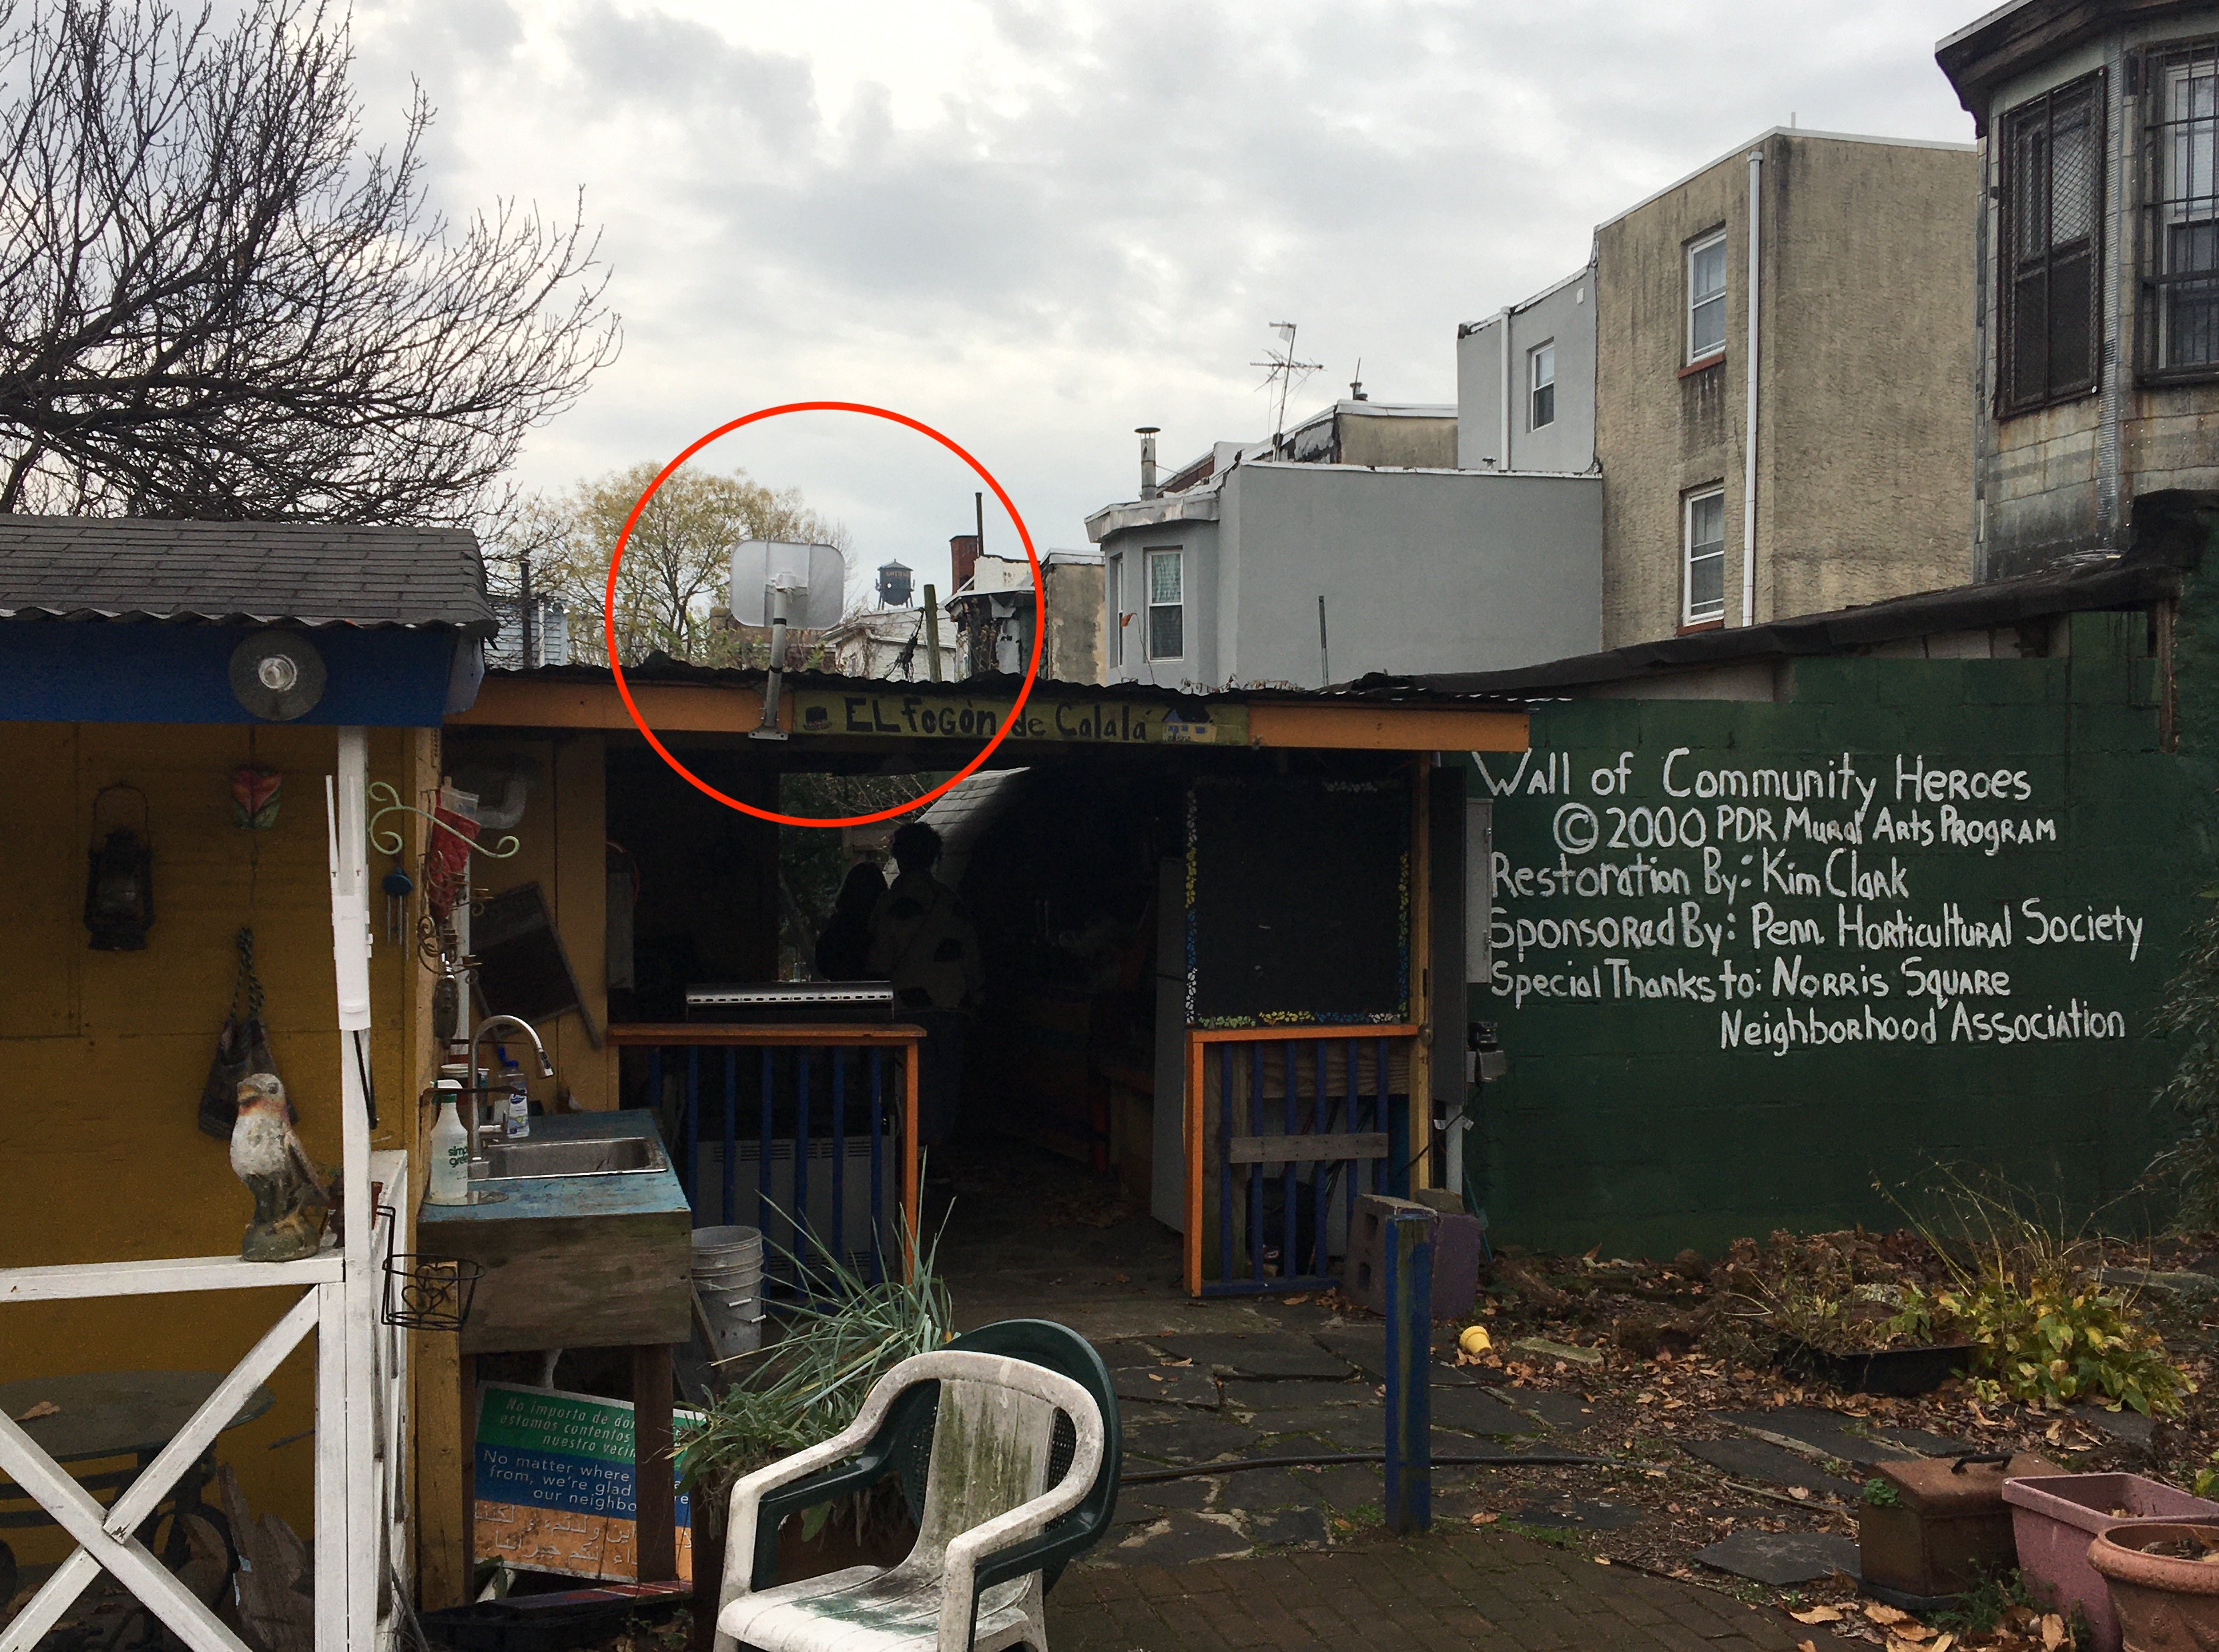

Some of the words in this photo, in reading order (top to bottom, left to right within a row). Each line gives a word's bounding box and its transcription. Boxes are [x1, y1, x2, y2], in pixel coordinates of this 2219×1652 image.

[1012, 706, 1047, 737] de
[1472, 747, 1570, 796] Wall
[1592, 751, 1634, 795] of
[1662, 747, 1877, 821] Community
[1895, 754, 2031, 802] Heroes
[1716, 804, 1778, 843] PDR
[1492, 851, 1691, 898] Restoration
[1702, 846, 1753, 905] By:
[1762, 847, 1821, 898] Kim
[1490, 906, 1674, 963] Sponsored
[1680, 901, 1736, 957] By:
[1837, 903, 2012, 950] Horticultural
[2021, 897, 2144, 962] Society
[1491, 959, 1602, 1009] Special
[1603, 957, 1717, 1003] Thanks
[1718, 959, 1762, 1001] to:
[1772, 954, 1889, 998] Norris
[1720, 1004, 1937, 1057] Neighborhood
[1951, 998, 2126, 1045] Association
[506, 1397, 525, 1411] No
[530, 1400, 587, 1421] importa
[592, 1409, 609, 1425] de
[500, 1414, 558, 1432] estamos
[563, 1422, 631, 1443] contentos
[543, 1434, 596, 1452] nuestro
[483, 1449, 508, 1465] No
[515, 1457, 573, 1475] matter
[580, 1464, 630, 1483] where
[489, 1464, 534, 1486] from,
[595, 1481, 632, 1497] glad
[533, 1489, 563, 1501] our
